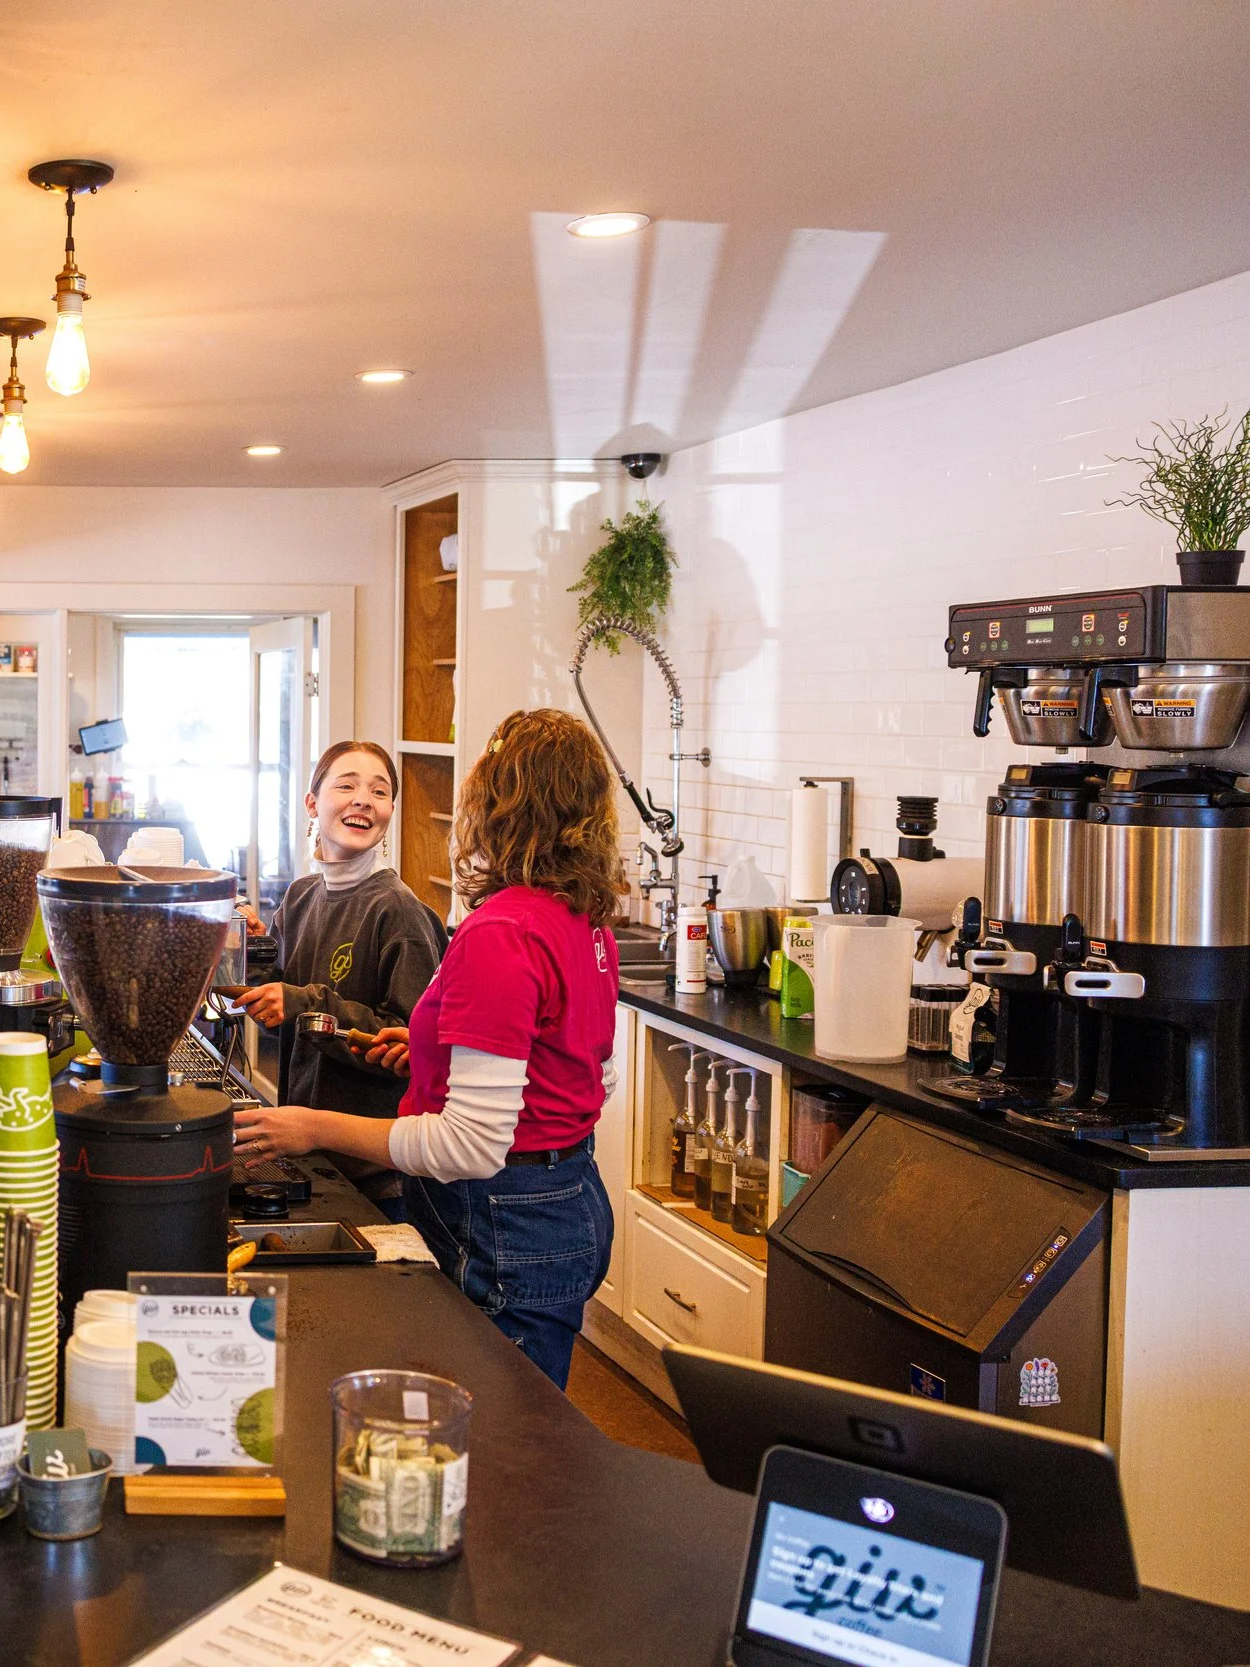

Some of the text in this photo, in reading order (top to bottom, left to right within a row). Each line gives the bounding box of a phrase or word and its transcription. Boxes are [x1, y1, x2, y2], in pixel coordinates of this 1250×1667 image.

[1029, 605, 1052, 613] BUNN
[172, 1305, 239, 1316] SPECIALS
[350, 1607, 404, 1632] FOOD
[410, 1630, 469, 1655] MENU
